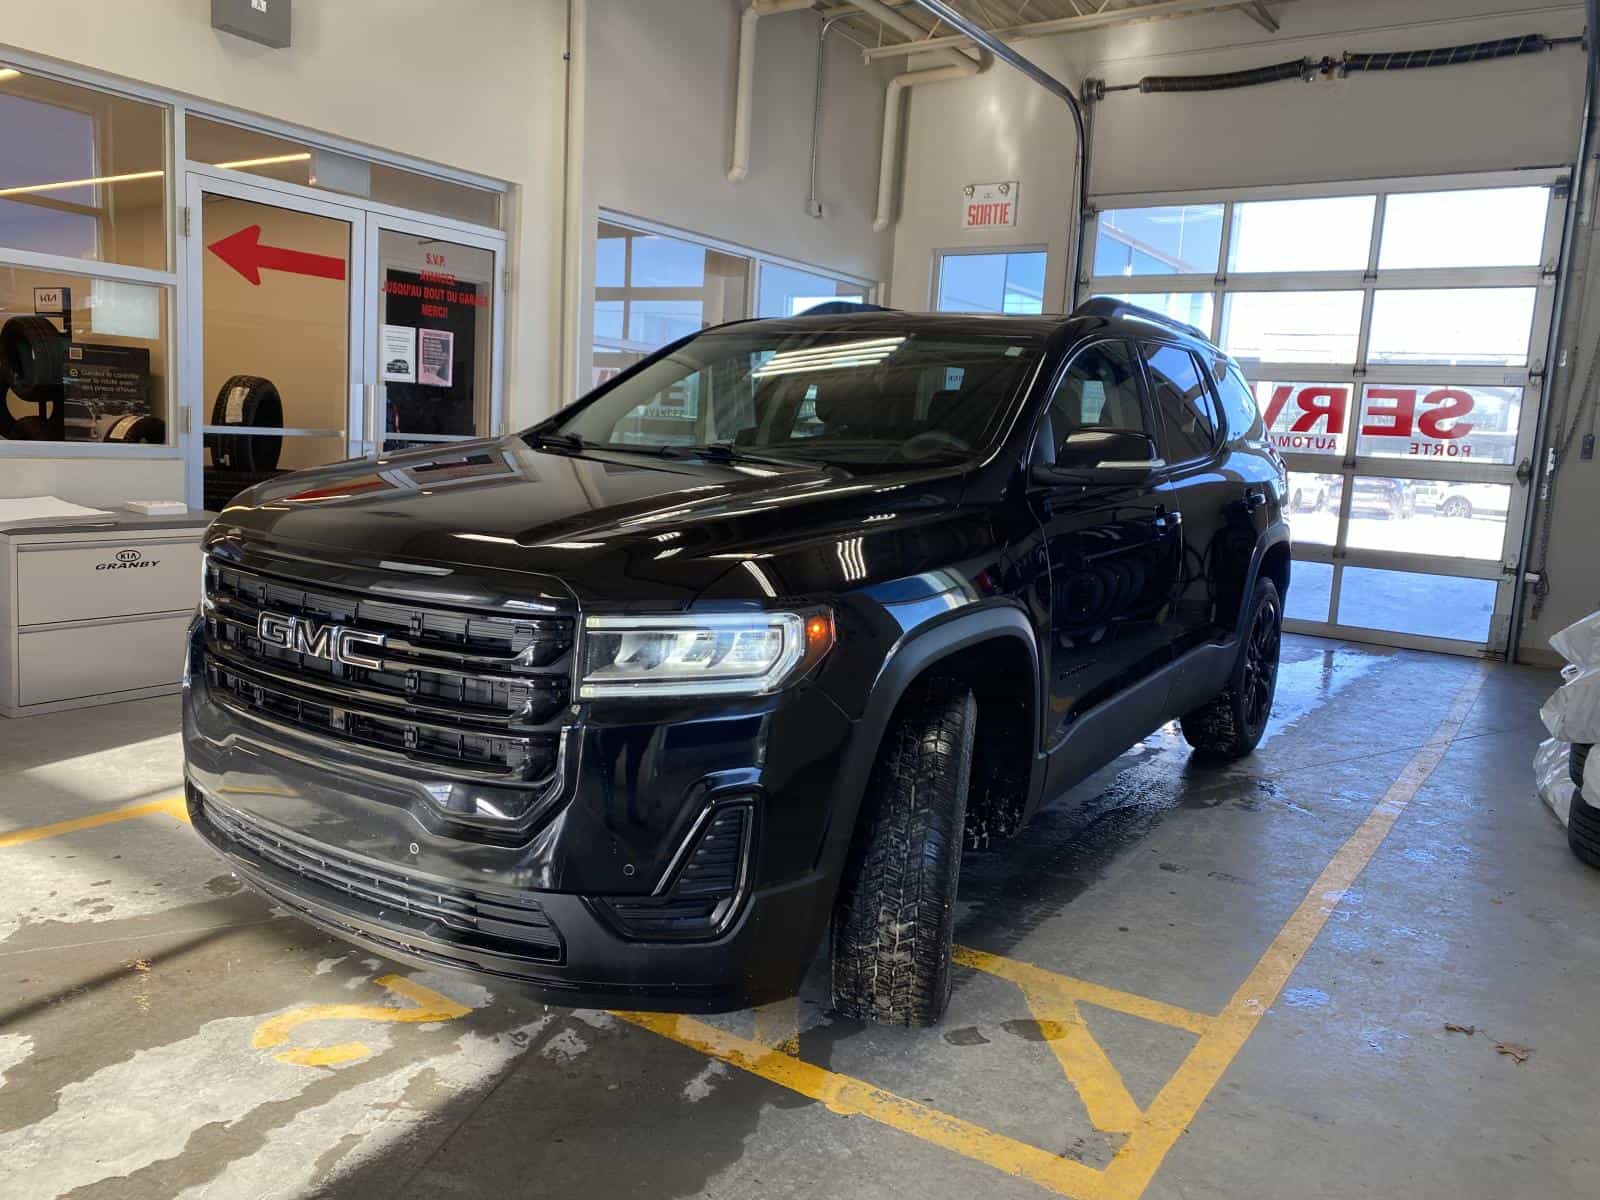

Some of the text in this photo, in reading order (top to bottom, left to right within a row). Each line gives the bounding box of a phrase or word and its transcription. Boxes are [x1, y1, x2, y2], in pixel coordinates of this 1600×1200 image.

[968, 203, 1010, 225] SORTIE
[424, 287, 445, 300] BOUT
[447, 291, 457, 303] DU
[95, 561, 160, 570] GRANBY
[257, 610, 385, 671] GMC
